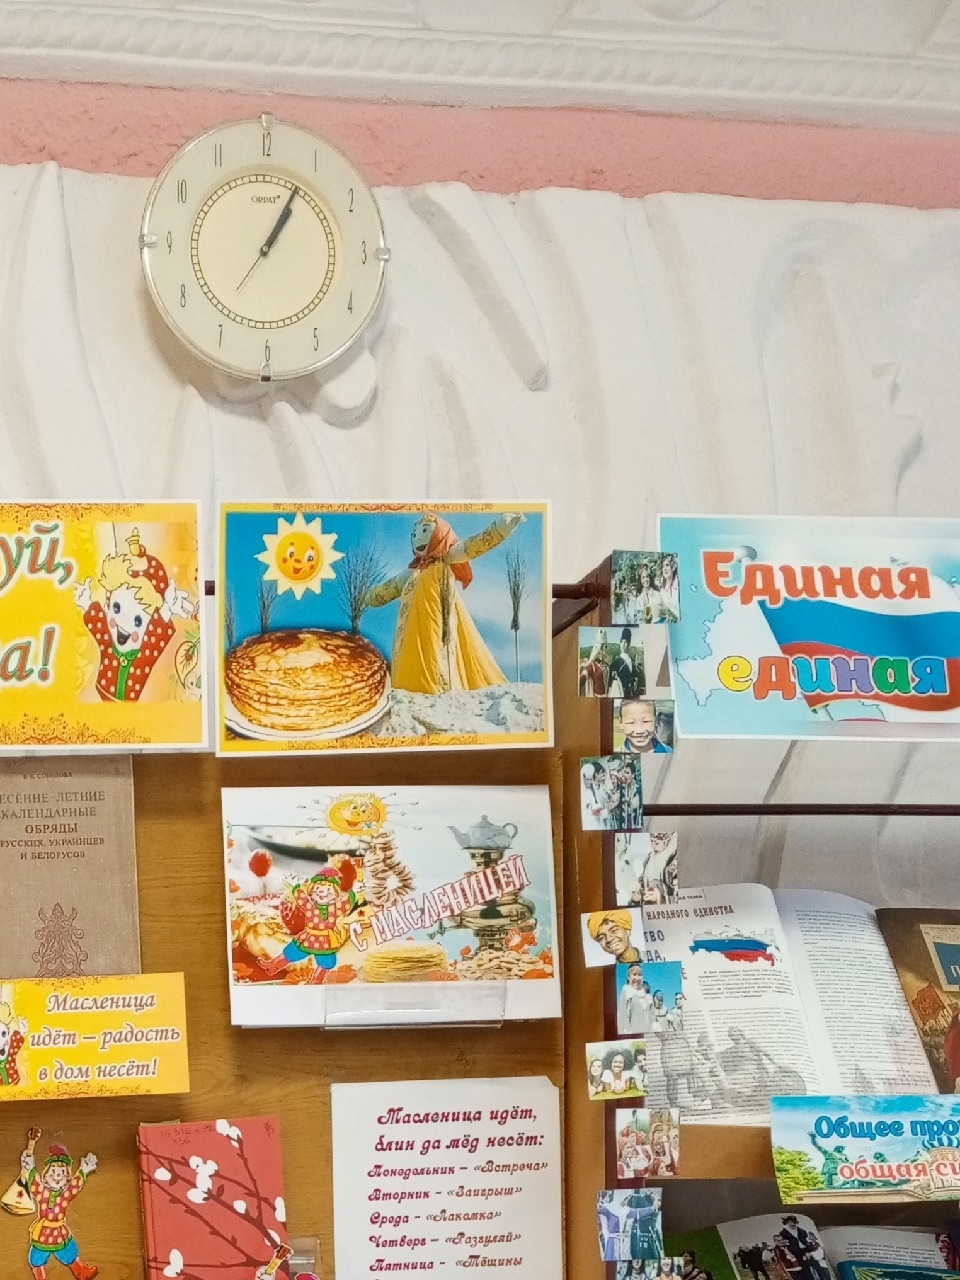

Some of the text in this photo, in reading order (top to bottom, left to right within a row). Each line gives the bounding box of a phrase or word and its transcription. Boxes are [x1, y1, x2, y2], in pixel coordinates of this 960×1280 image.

[214, 143, 222, 167] 11
[262, 132, 271, 157] 12
[177, 179, 187, 203] 10
[348, 188, 354, 212] 2
[702, 551, 931, 605] Единая
[717, 655, 948, 701] единая
[1, 807, 97, 820] КАЛЕНДАРНЫЕ
[25, 823, 78, 834] ОБРЯДЫ
[49, 838, 105, 846] УКРАИНЦЕВ
[372, 854, 531, 945] МАСЛЕНИЦЕЙ
[47, 993, 157, 1012] Масленица
[30, 1026, 181, 1050] идёт радость
[39, 1059, 158, 1083] в дом несёт!
[489, 1106, 538, 1126] идёт,
[814, 1115, 905, 1141] Общее
[375, 1133, 545, 1155] блин да мёд несёт:
[367, 1164, 455, 1180] Понедельник
[839, 1159, 929, 1182] общая
[368, 1188, 430, 1203] Вторник
[370, 1211, 409, 1226] Среда
[369, 1235, 427, 1249] Четверг
[369, 1258, 434, 1273] Пятница
